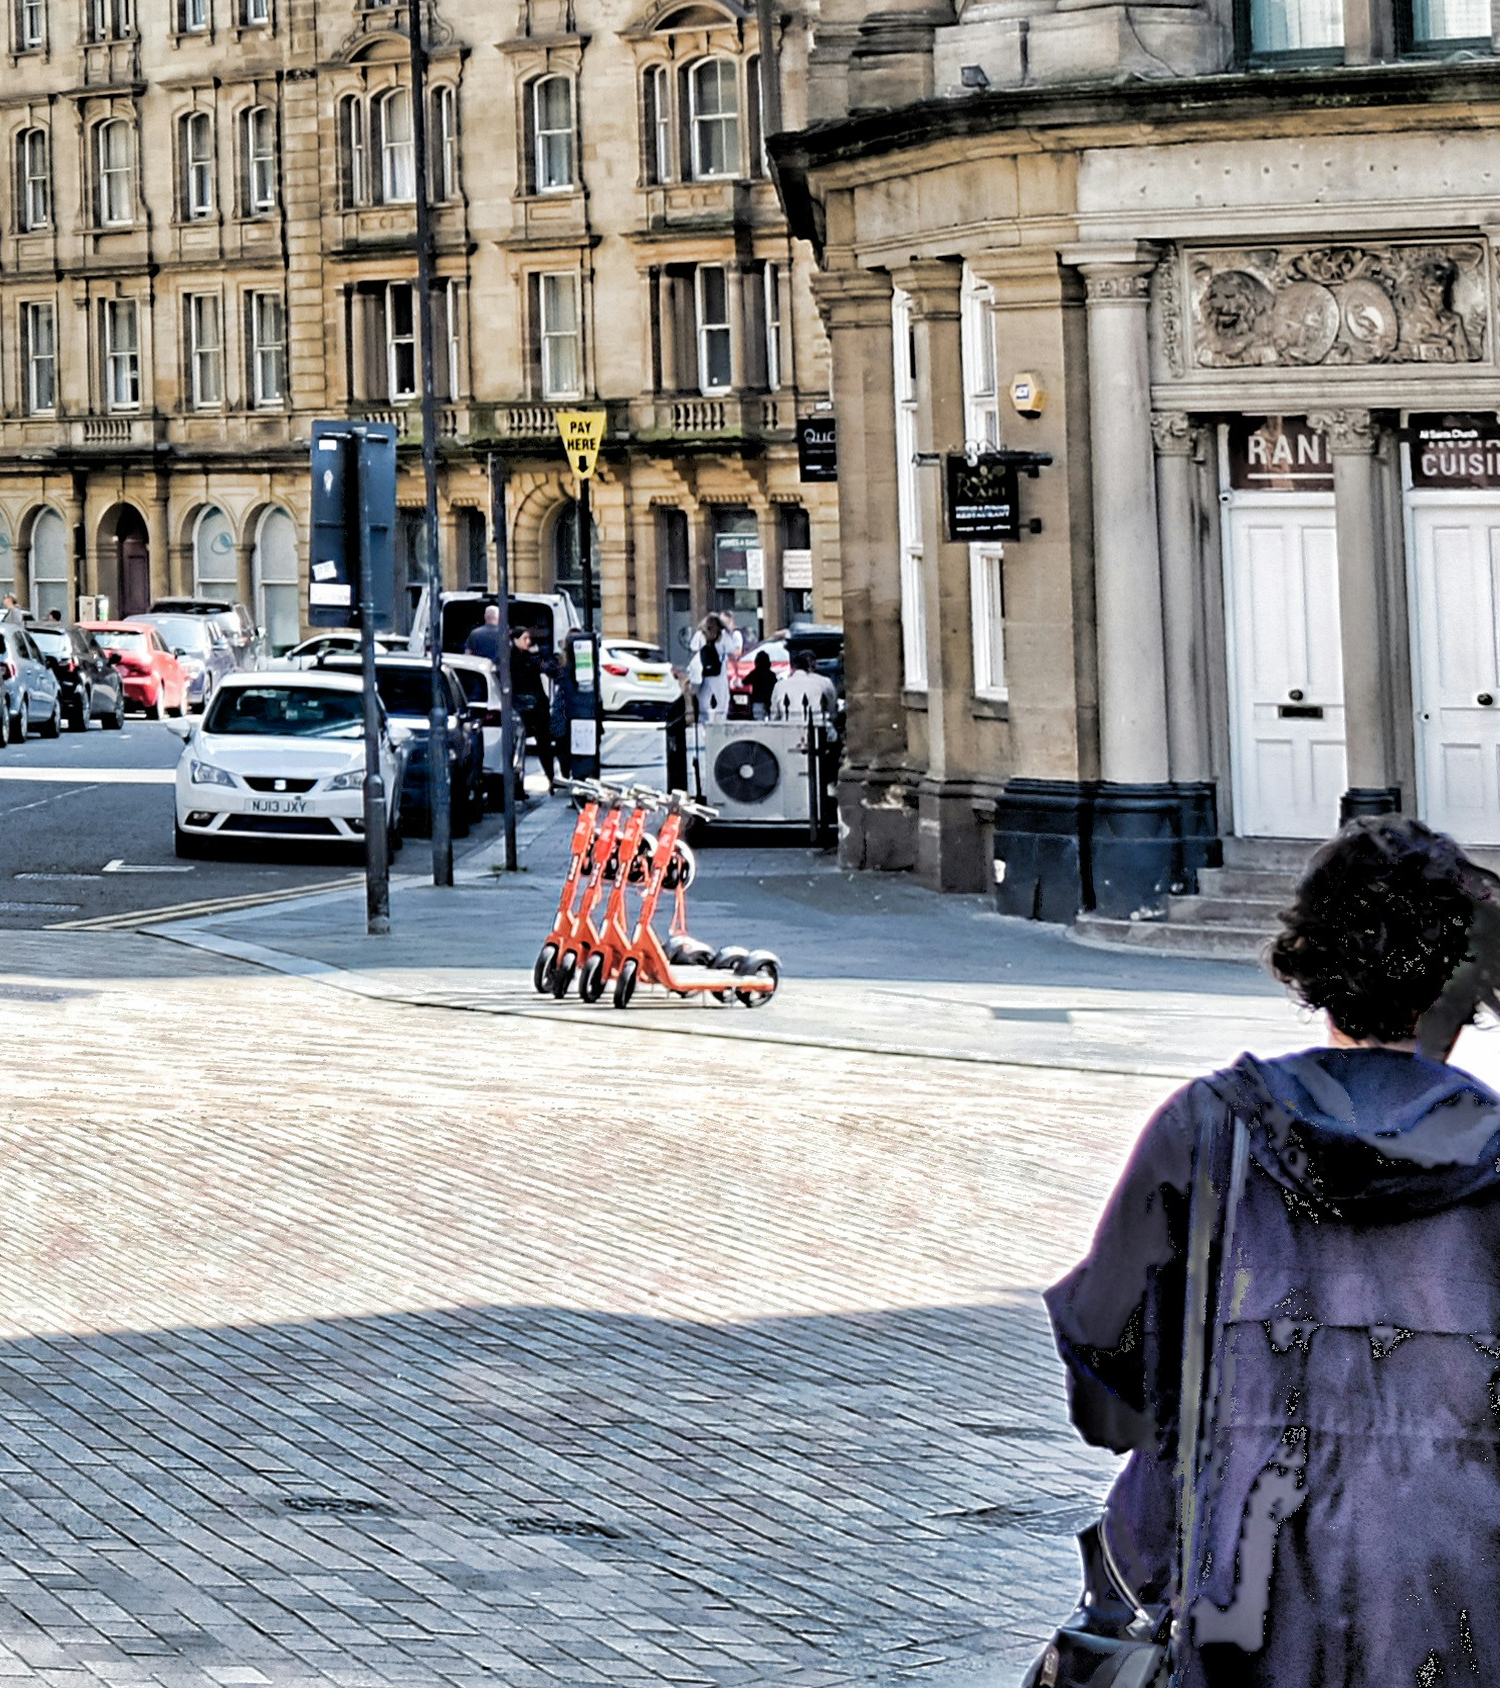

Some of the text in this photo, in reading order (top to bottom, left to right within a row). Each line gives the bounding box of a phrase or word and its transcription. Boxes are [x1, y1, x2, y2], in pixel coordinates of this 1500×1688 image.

[570, 421, 592, 433] PAY
[567, 438, 596, 450] HERE
[1422, 453, 1500, 476] CUISI
[252, 801, 307, 813] NJ13 JXY
